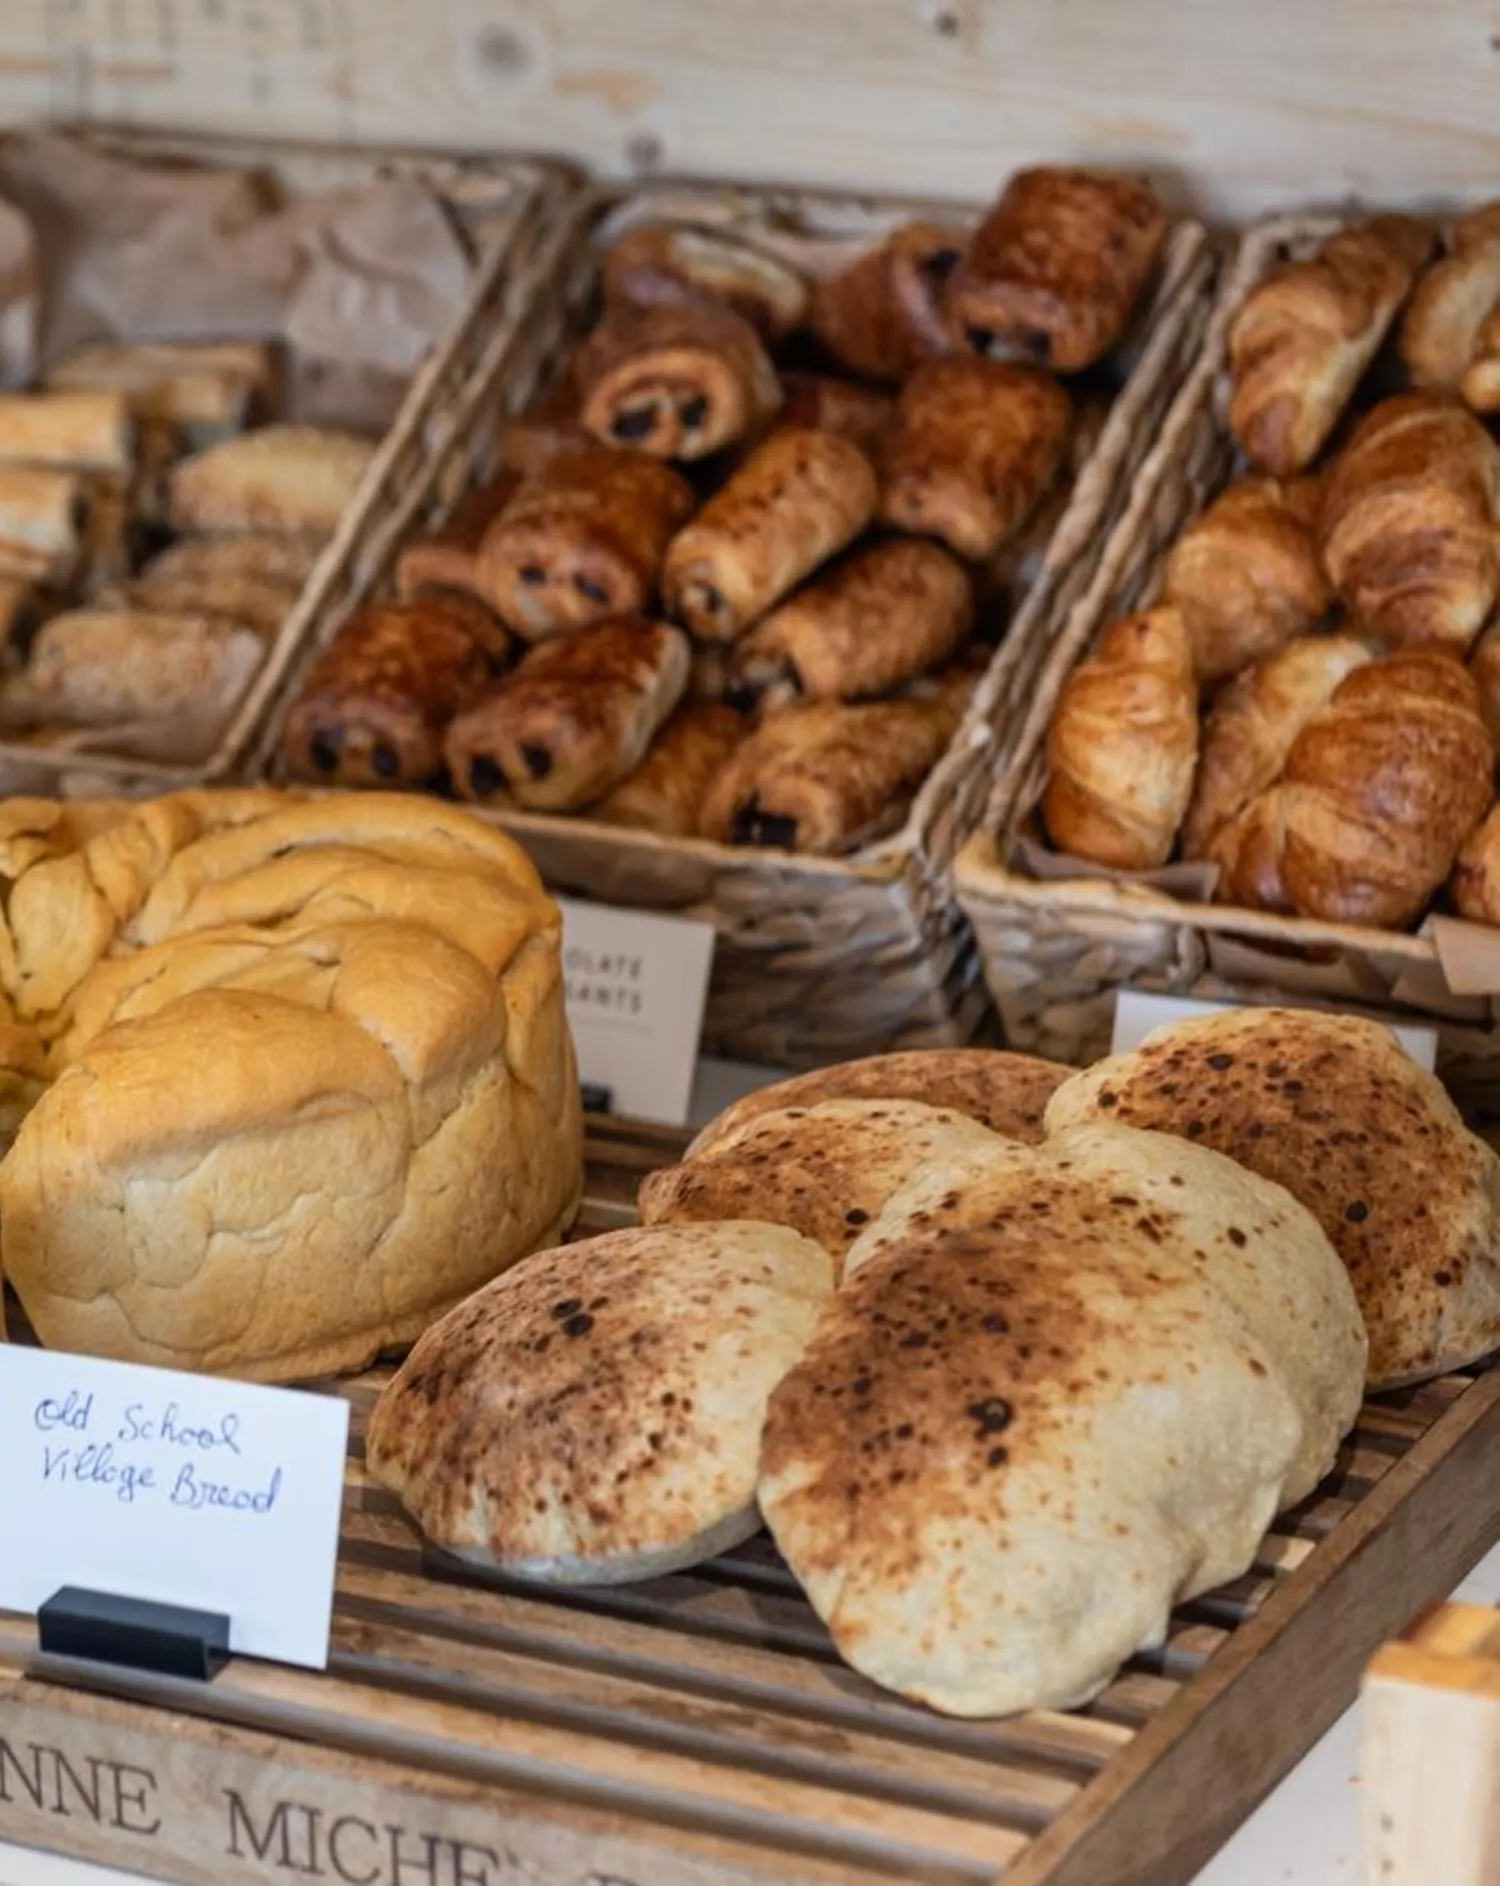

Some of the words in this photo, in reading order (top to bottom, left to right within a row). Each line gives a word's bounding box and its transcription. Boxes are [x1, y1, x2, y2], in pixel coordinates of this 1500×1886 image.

[35, 1390, 94, 1432] Old
[117, 1402, 242, 1456] School
[42, 1443, 157, 1502] Village
[221, 1786, 499, 1886] MICHE
